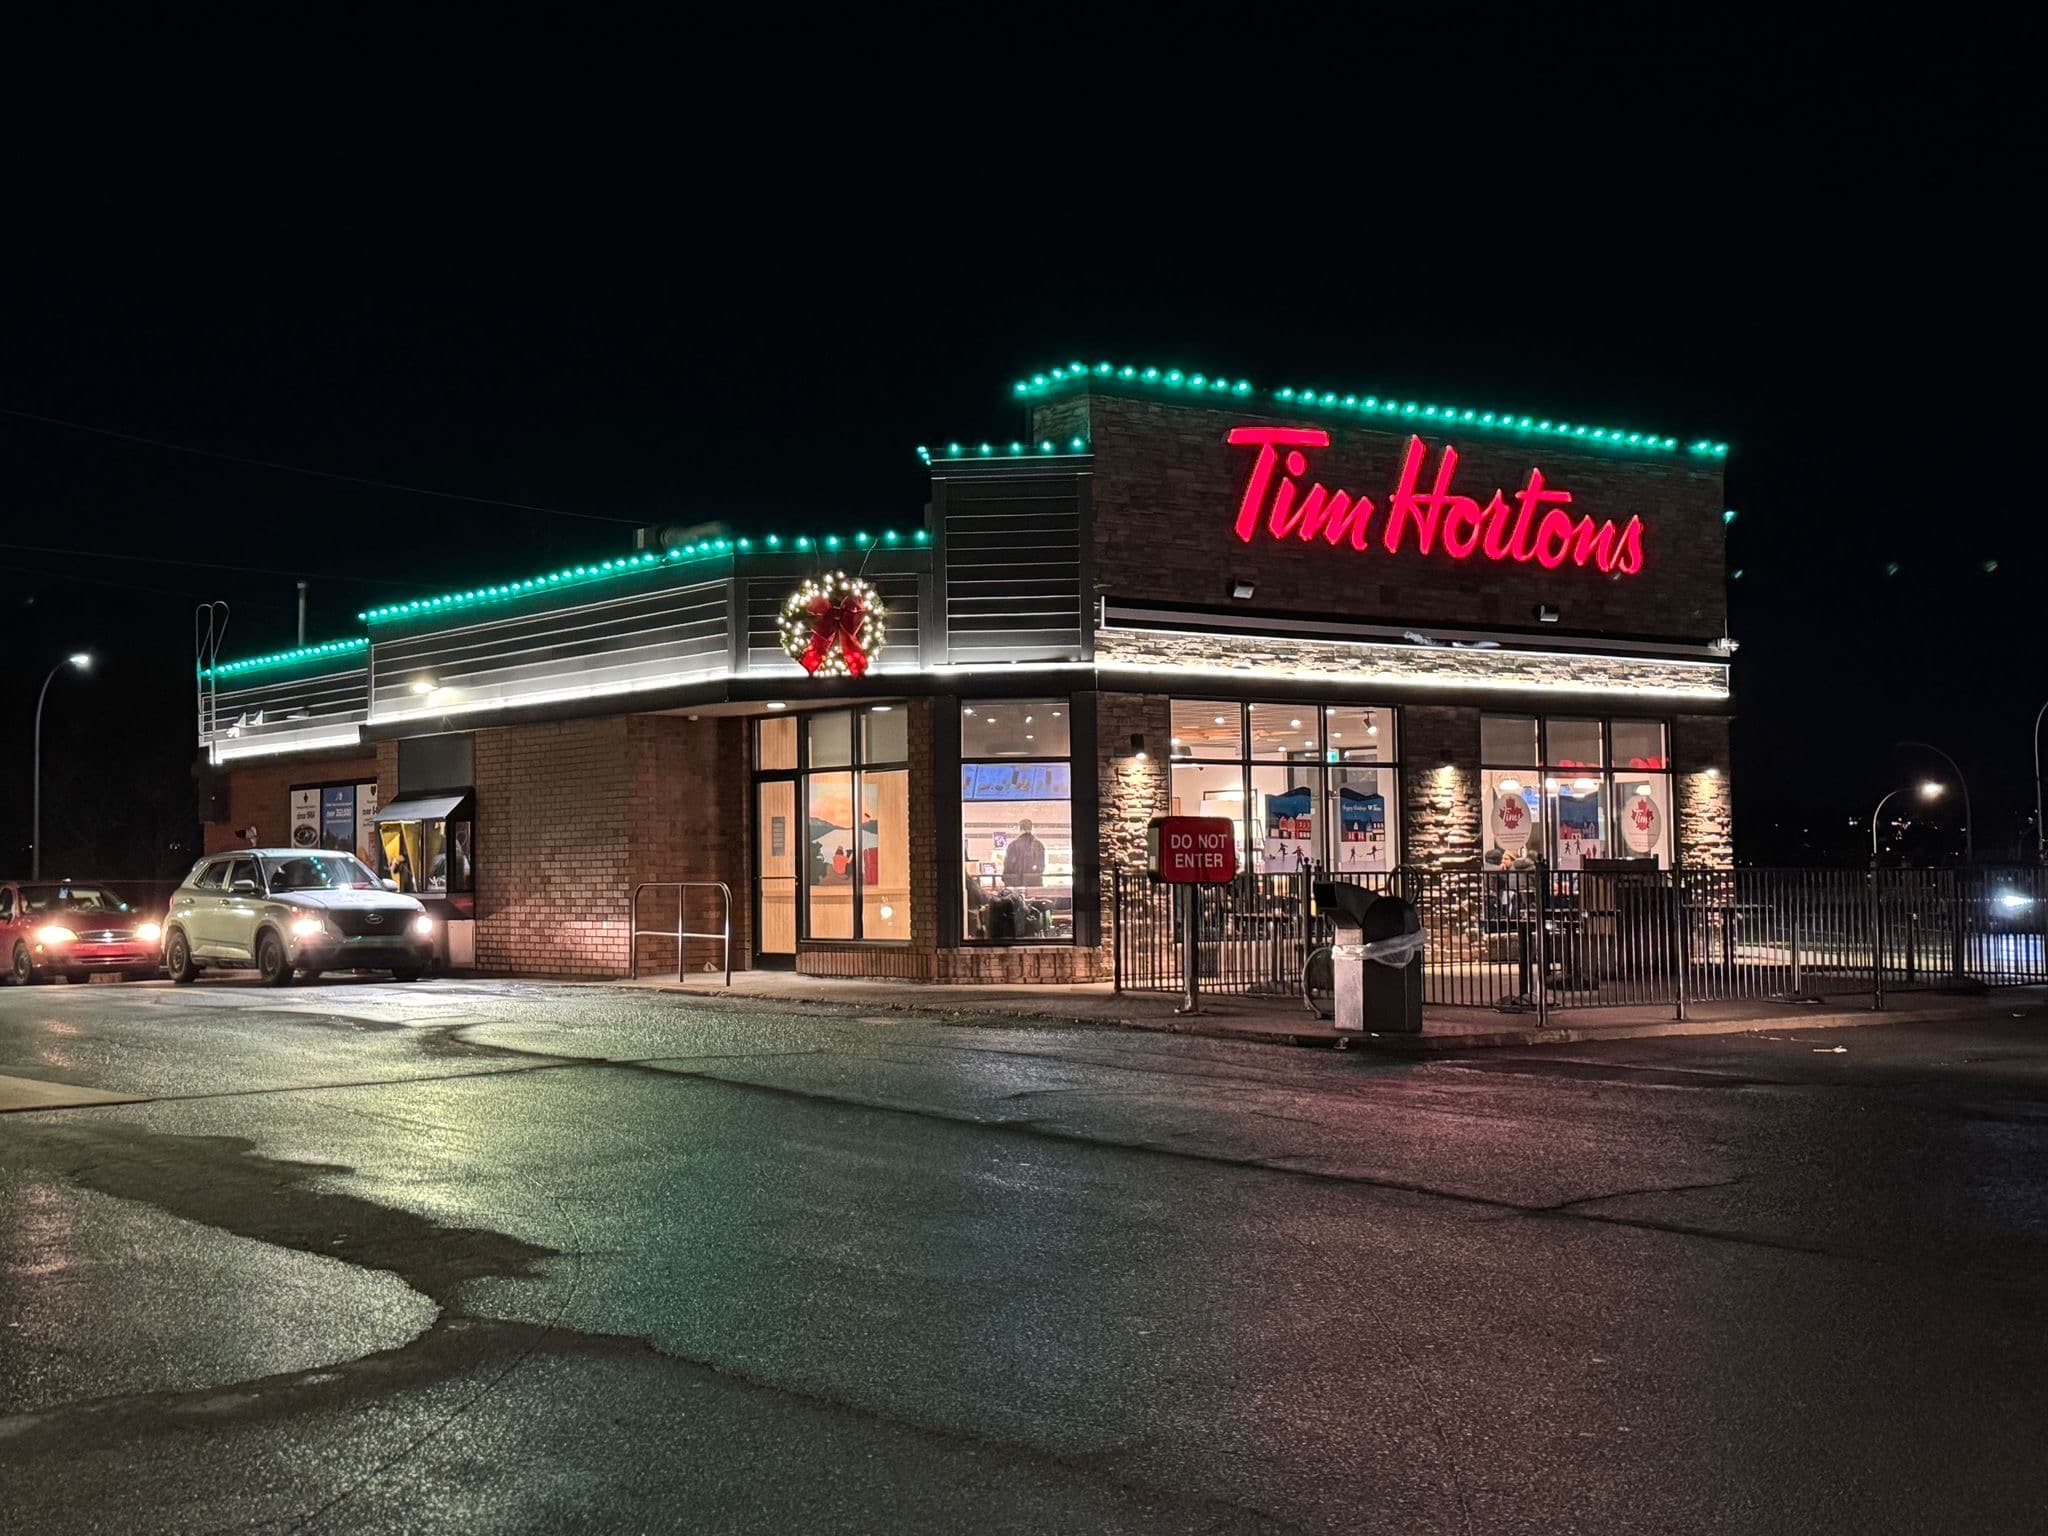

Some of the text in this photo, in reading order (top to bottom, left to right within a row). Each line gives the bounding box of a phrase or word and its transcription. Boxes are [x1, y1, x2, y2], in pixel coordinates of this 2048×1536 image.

[1227, 426, 1643, 575] Tim Hortons
[1171, 834, 1228, 849] DO NOT
[1175, 853, 1223, 868] ENTER
